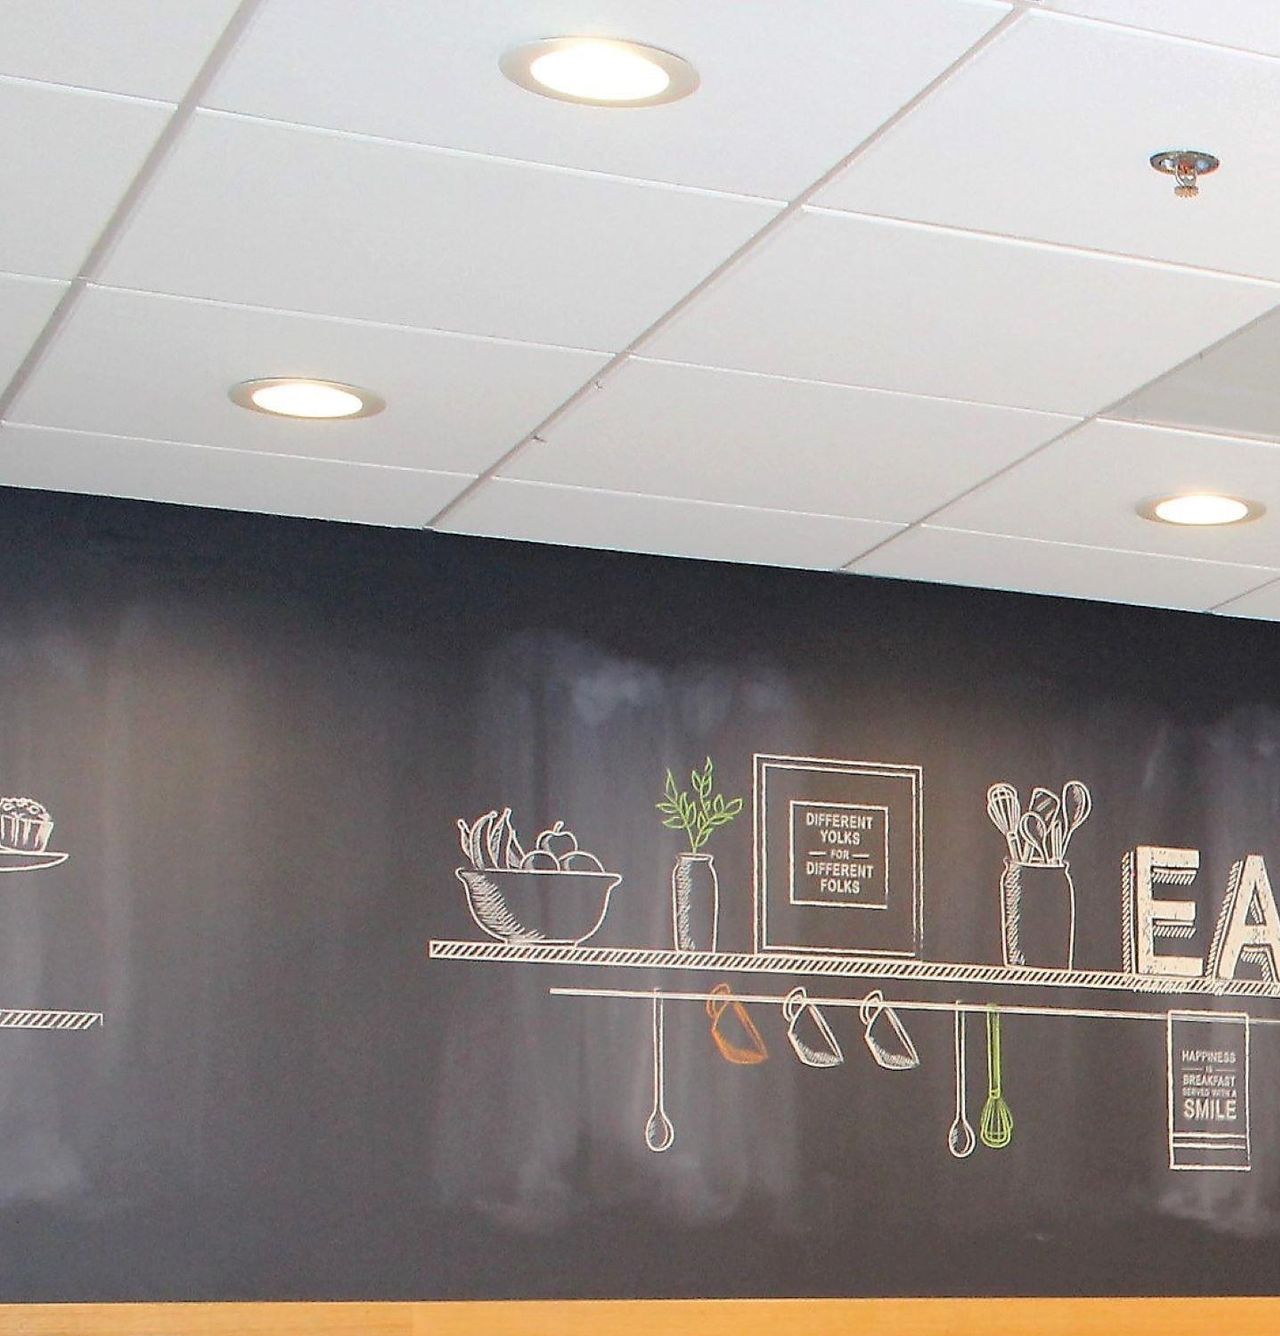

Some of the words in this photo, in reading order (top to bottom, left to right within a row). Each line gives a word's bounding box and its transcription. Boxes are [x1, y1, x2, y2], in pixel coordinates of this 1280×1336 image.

[806, 812, 873, 830] DIFFERENT
[820, 829, 860, 845] YOLKS
[830, 849, 850, 860] FOR
[806, 861, 874, 879] DIFFERENT
[820, 878, 860, 894] FOLKS
[1182, 1050, 1236, 1063] HAPPINESS
[1183, 1074, 1235, 1087] BREAKFAST
[1231, 1089, 1237, 1098] A
[1184, 1098, 1237, 1120] SMILE
